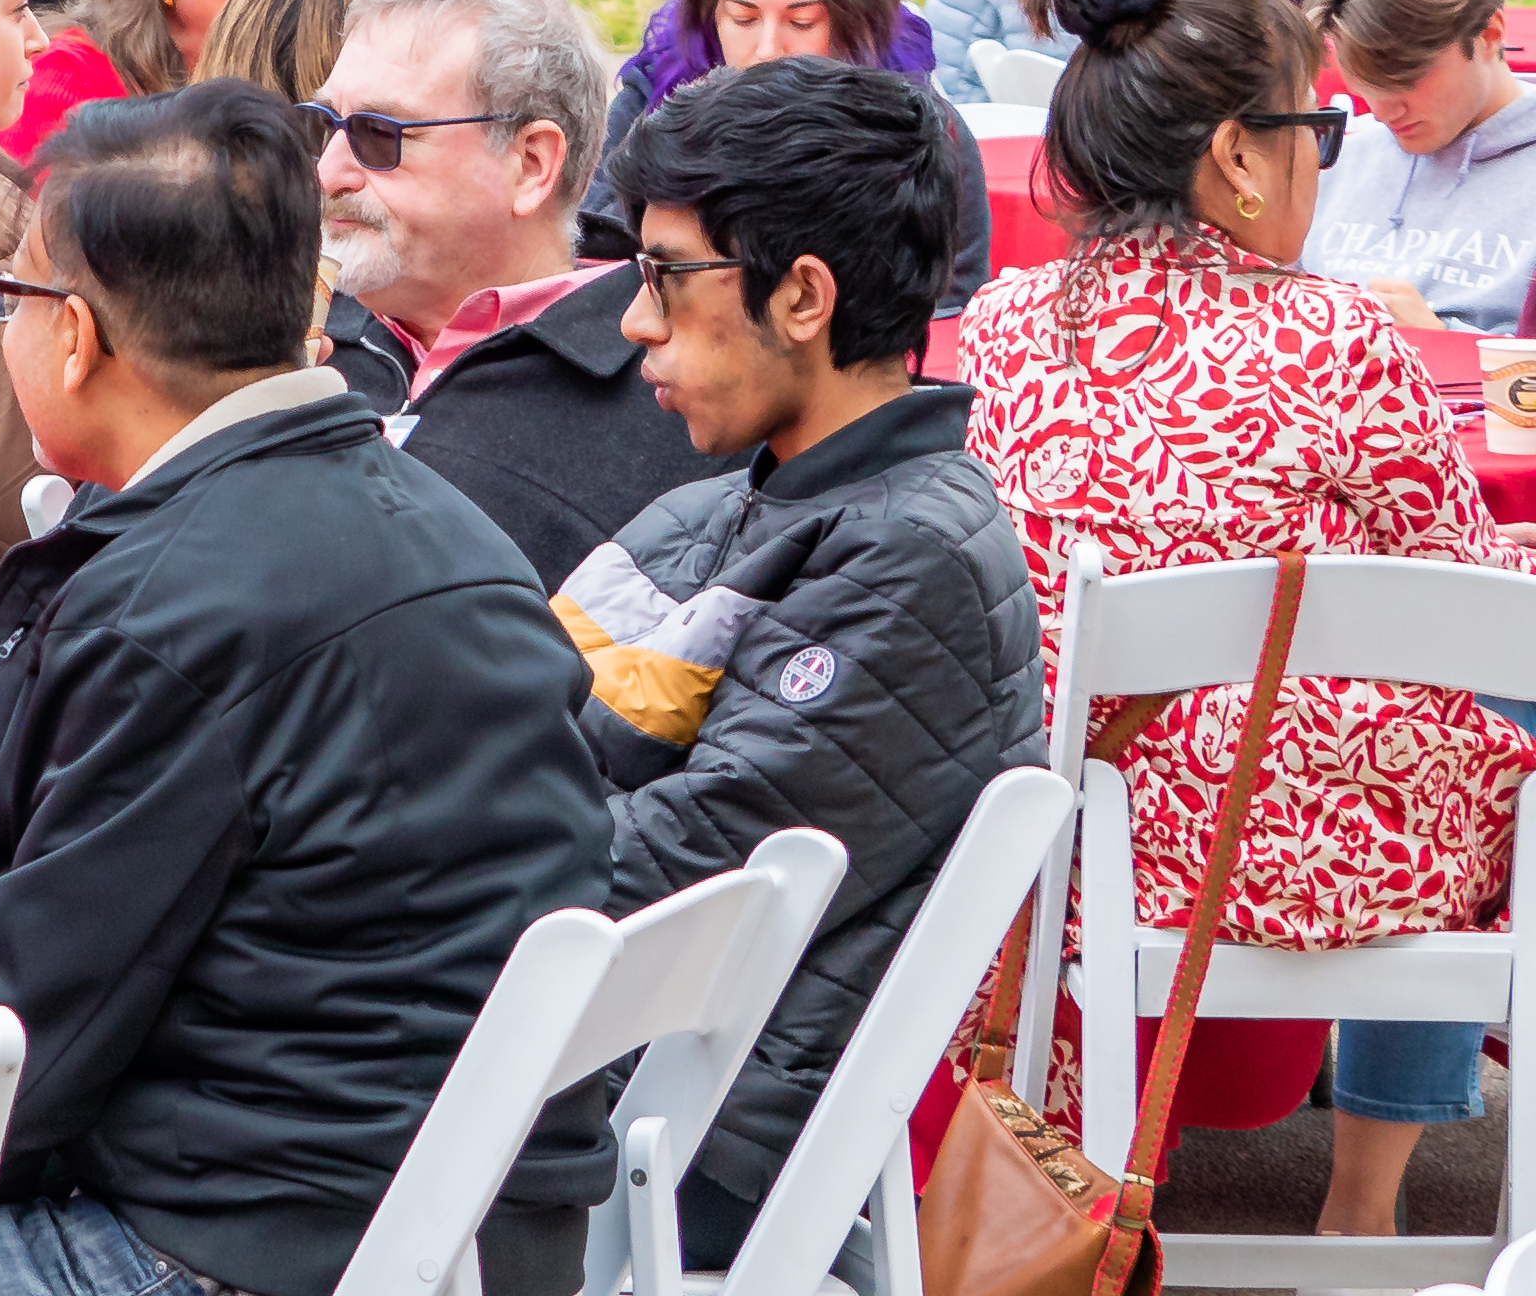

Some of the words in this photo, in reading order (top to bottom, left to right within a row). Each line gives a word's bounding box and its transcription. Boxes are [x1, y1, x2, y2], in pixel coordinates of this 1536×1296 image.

[1321, 221, 1532, 270] CHAPMAN
[1323, 257, 1388, 275] TRACK
[1415, 261, 1496, 290] FIELD
